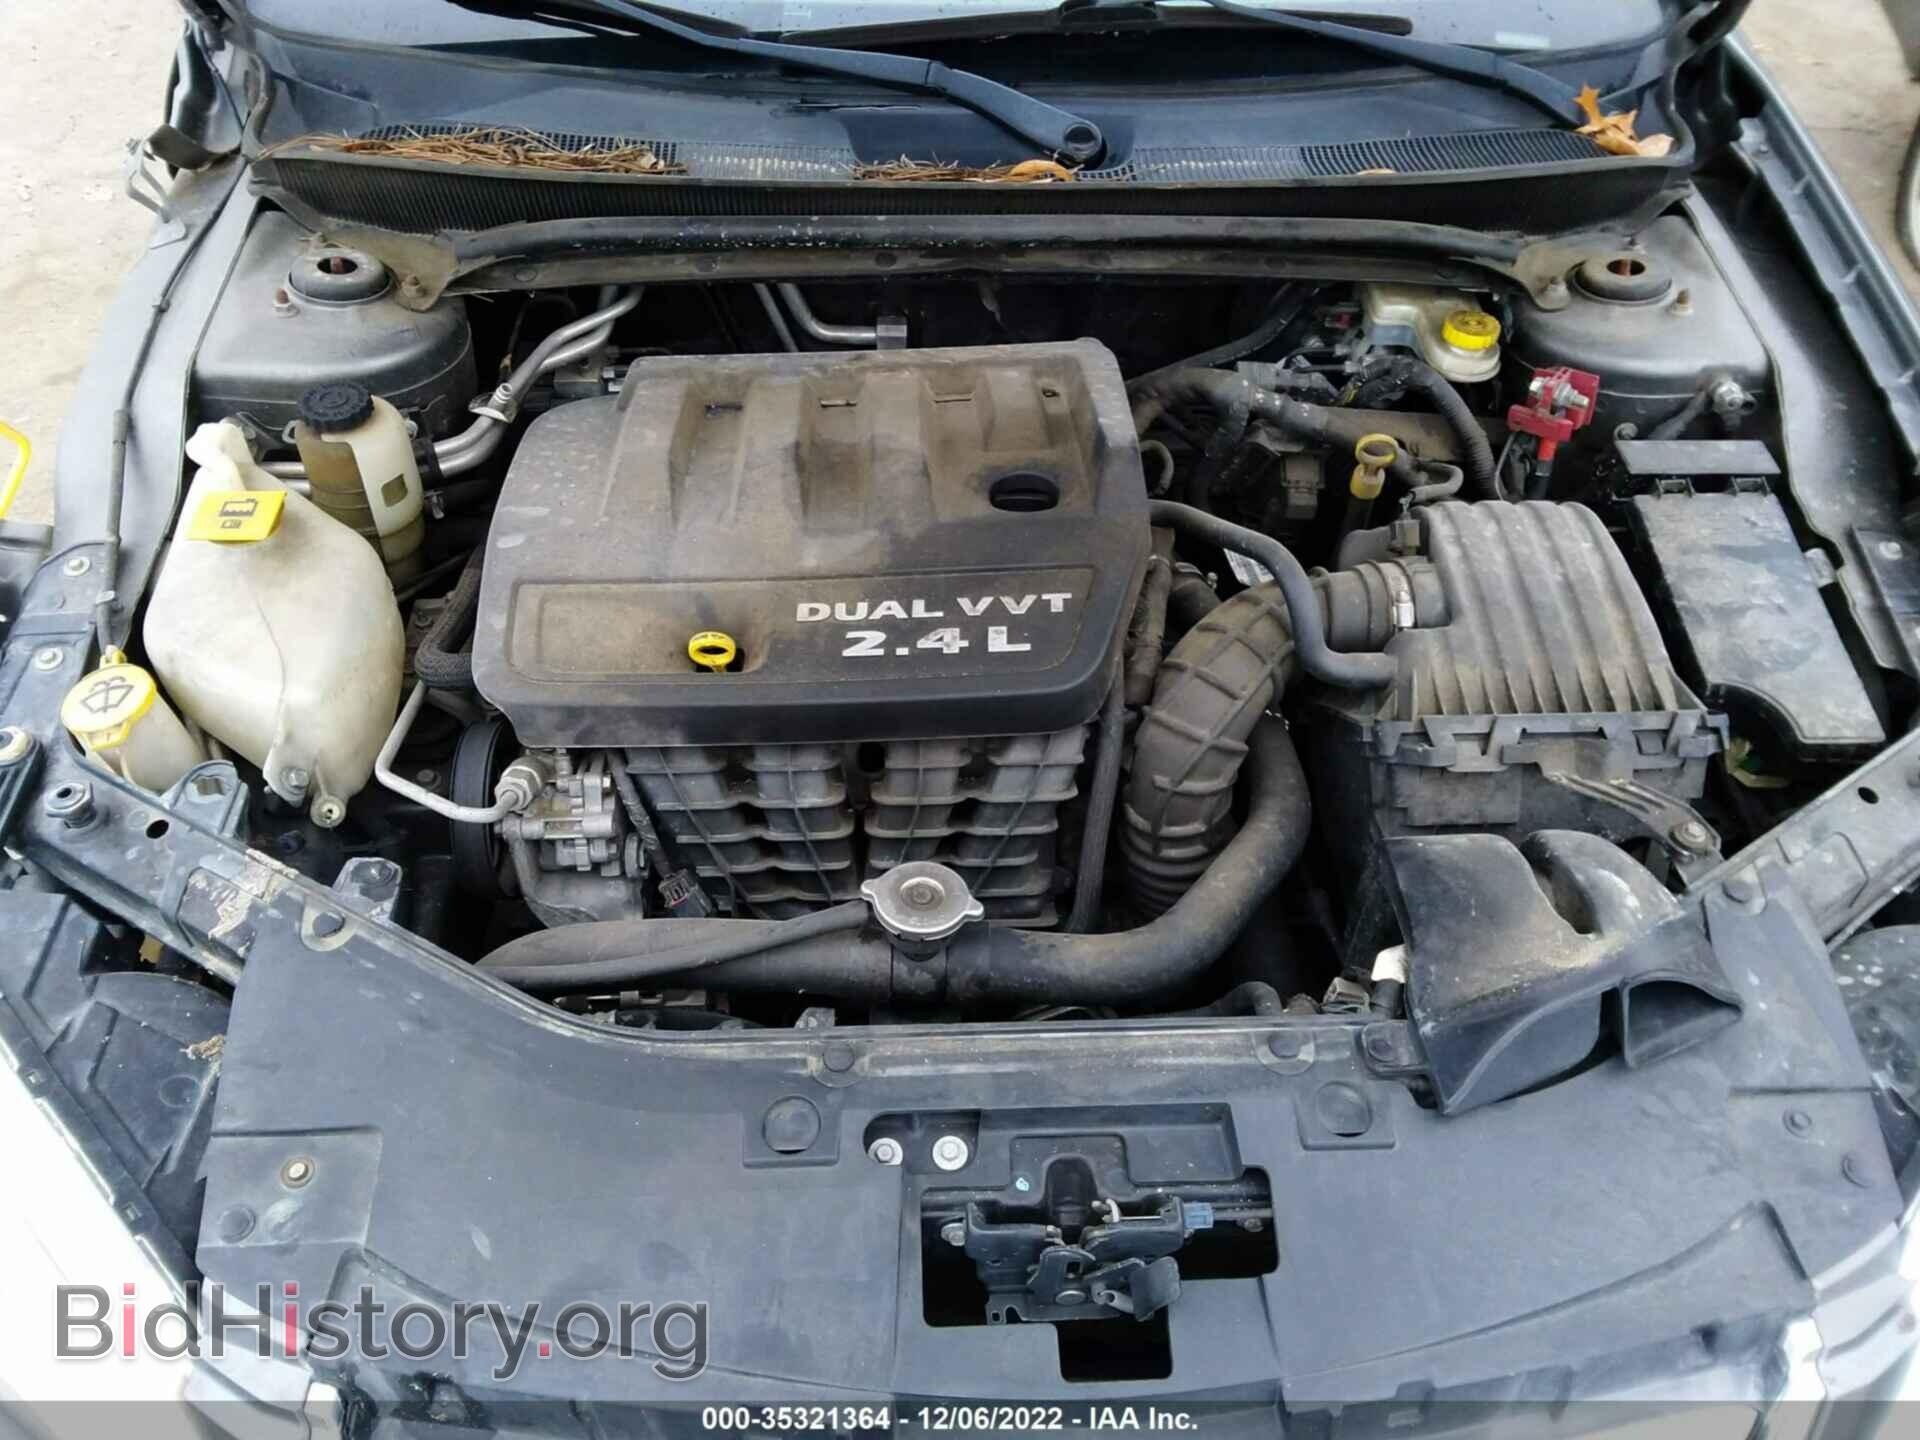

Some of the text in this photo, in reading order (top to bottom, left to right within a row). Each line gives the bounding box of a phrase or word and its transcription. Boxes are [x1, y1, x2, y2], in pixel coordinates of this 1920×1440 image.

[796, 592, 1073, 622] DUAL VVT
[841, 625, 1032, 657] 2.4 L
